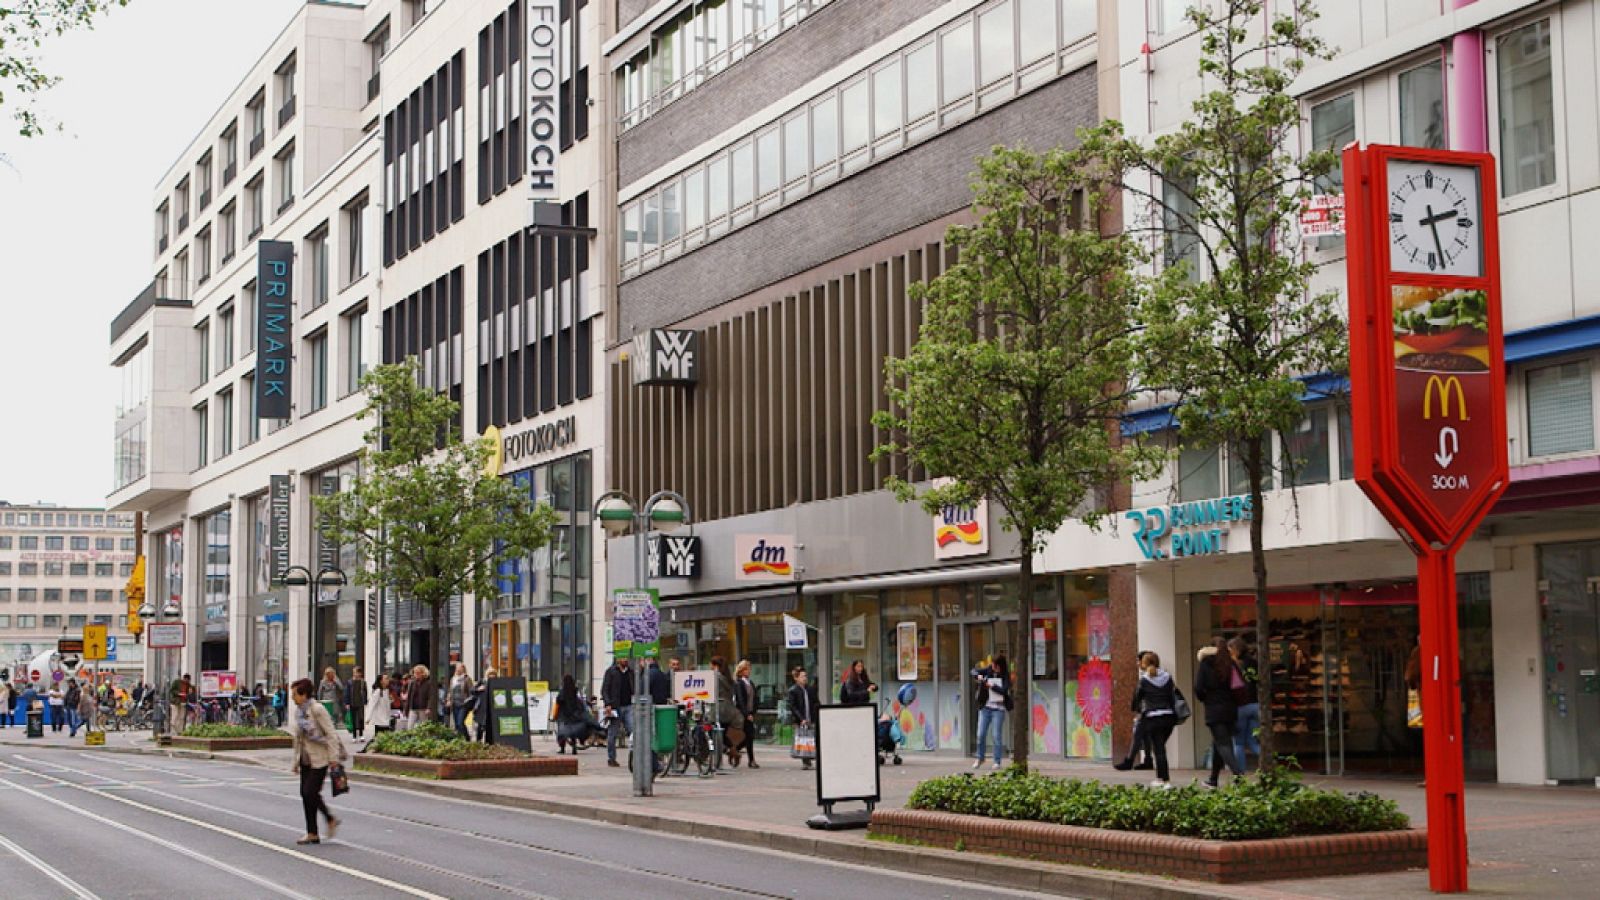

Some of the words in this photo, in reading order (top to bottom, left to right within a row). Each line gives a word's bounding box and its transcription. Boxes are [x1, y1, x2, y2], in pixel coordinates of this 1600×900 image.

[531, 5, 555, 191] FOTOKOCH
[264, 260, 287, 396] PRIMARK
[655, 329, 694, 379] WMF
[504, 415, 576, 464] FOTOKOCH
[1432, 475, 1456, 490] 300
[1458, 475, 1470, 490] M
[1170, 494, 1253, 528] RUNNERS
[666, 538, 695, 576] WMF
[751, 539, 785, 562] dm
[1172, 529, 1222, 557] POINT
[684, 675, 705, 688] dm
